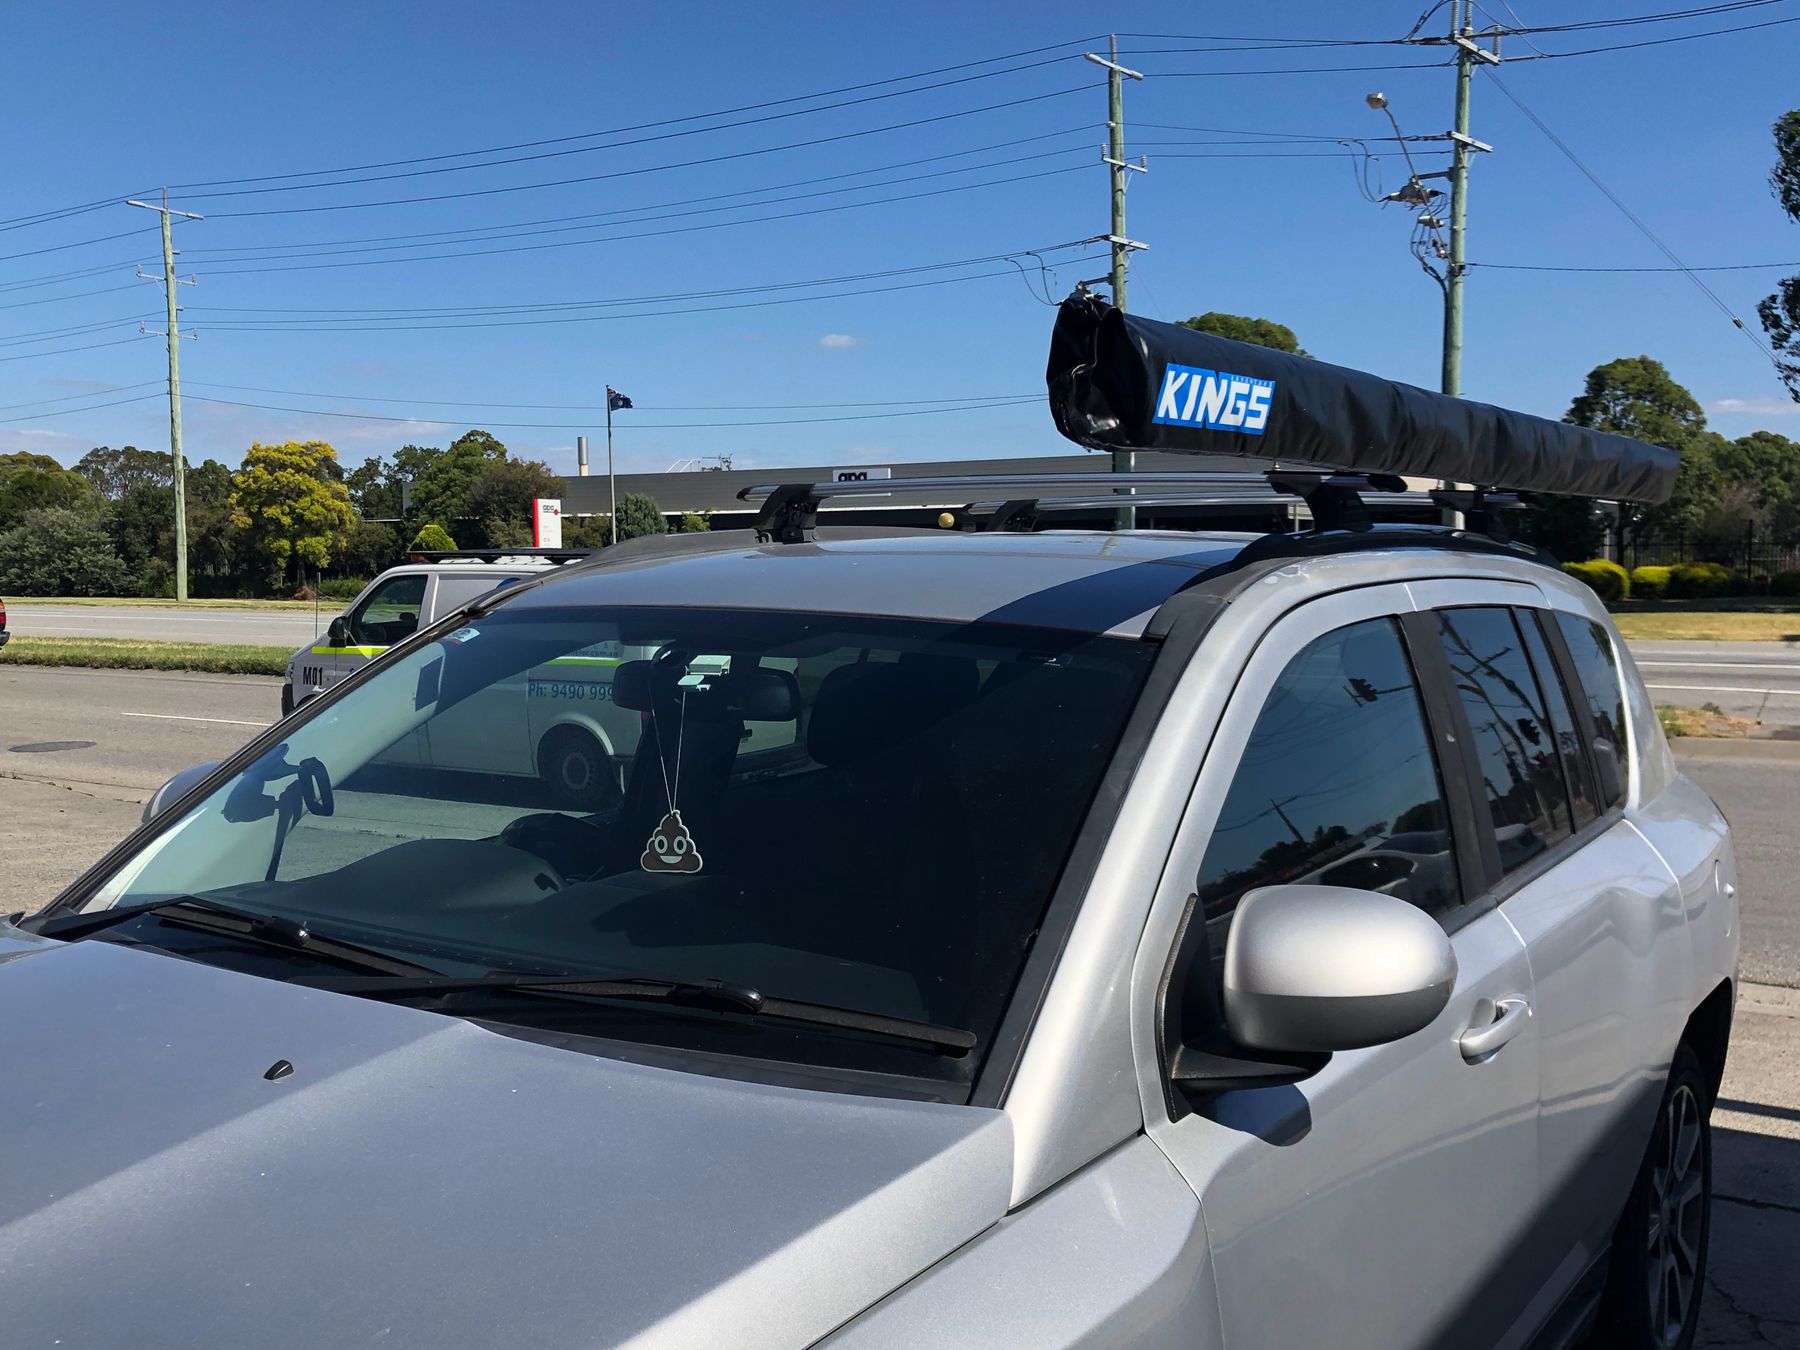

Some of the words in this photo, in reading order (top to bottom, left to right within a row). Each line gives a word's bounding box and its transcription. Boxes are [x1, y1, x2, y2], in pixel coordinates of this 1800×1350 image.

[1158, 370, 1272, 429] KINGS
[303, 667, 323, 685] M01
[528, 682, 547, 697] Ph:
[551, 684, 585, 699] 9490
[590, 685, 614, 701] 999
